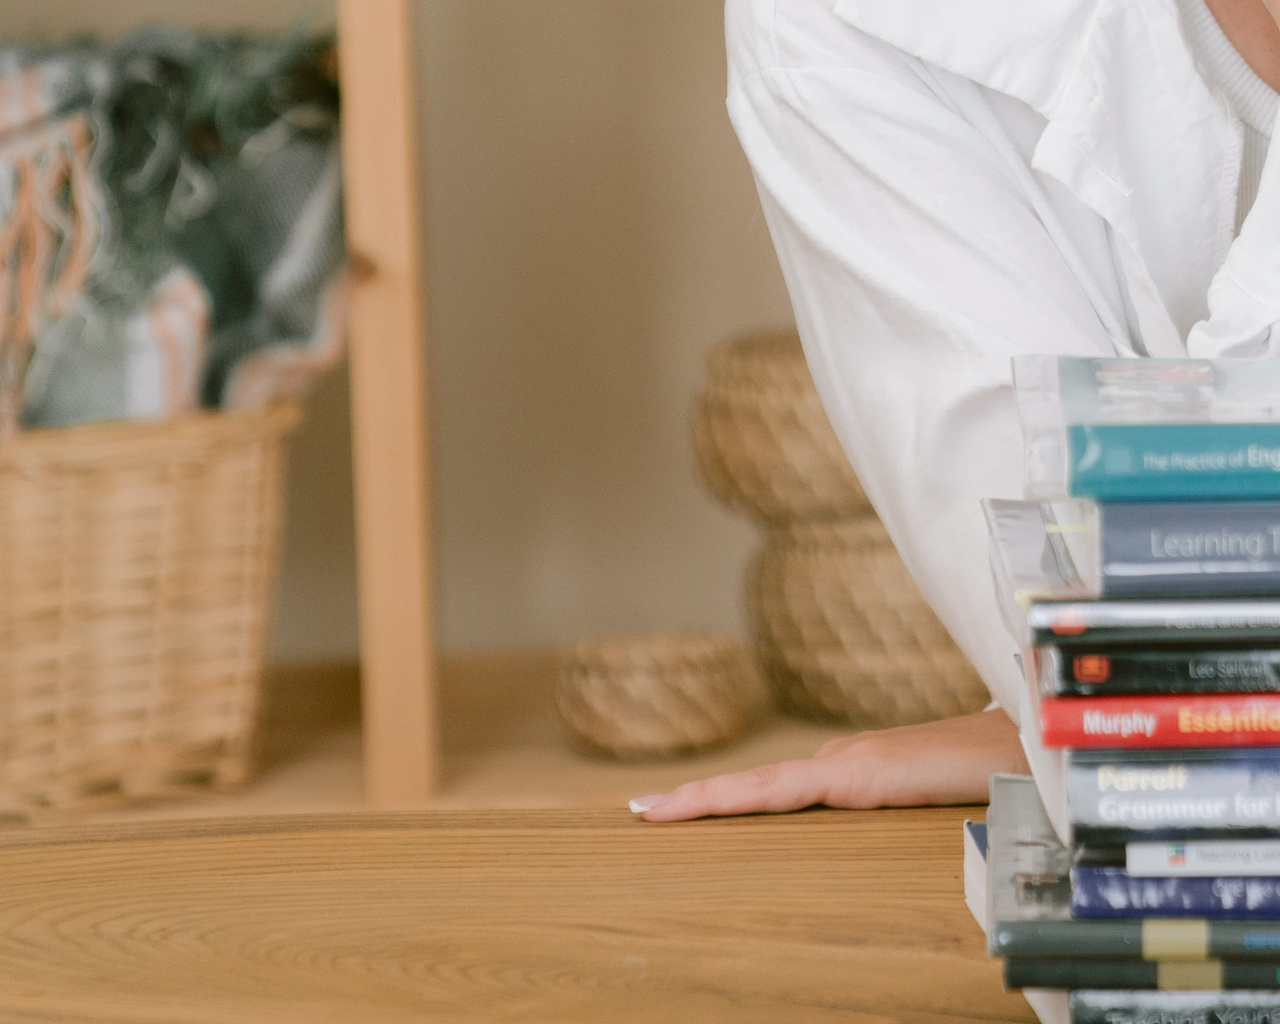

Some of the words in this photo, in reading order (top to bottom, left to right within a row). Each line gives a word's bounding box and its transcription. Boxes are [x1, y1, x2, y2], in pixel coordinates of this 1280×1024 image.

[1171, 451, 1226, 471] Practice
[1228, 449, 1243, 469] of
[1151, 527, 1262, 561] Learning
[1083, 710, 1155, 738] Murphy
[1100, 796, 1226, 822] Grammar
[1235, 793, 1269, 818] for
